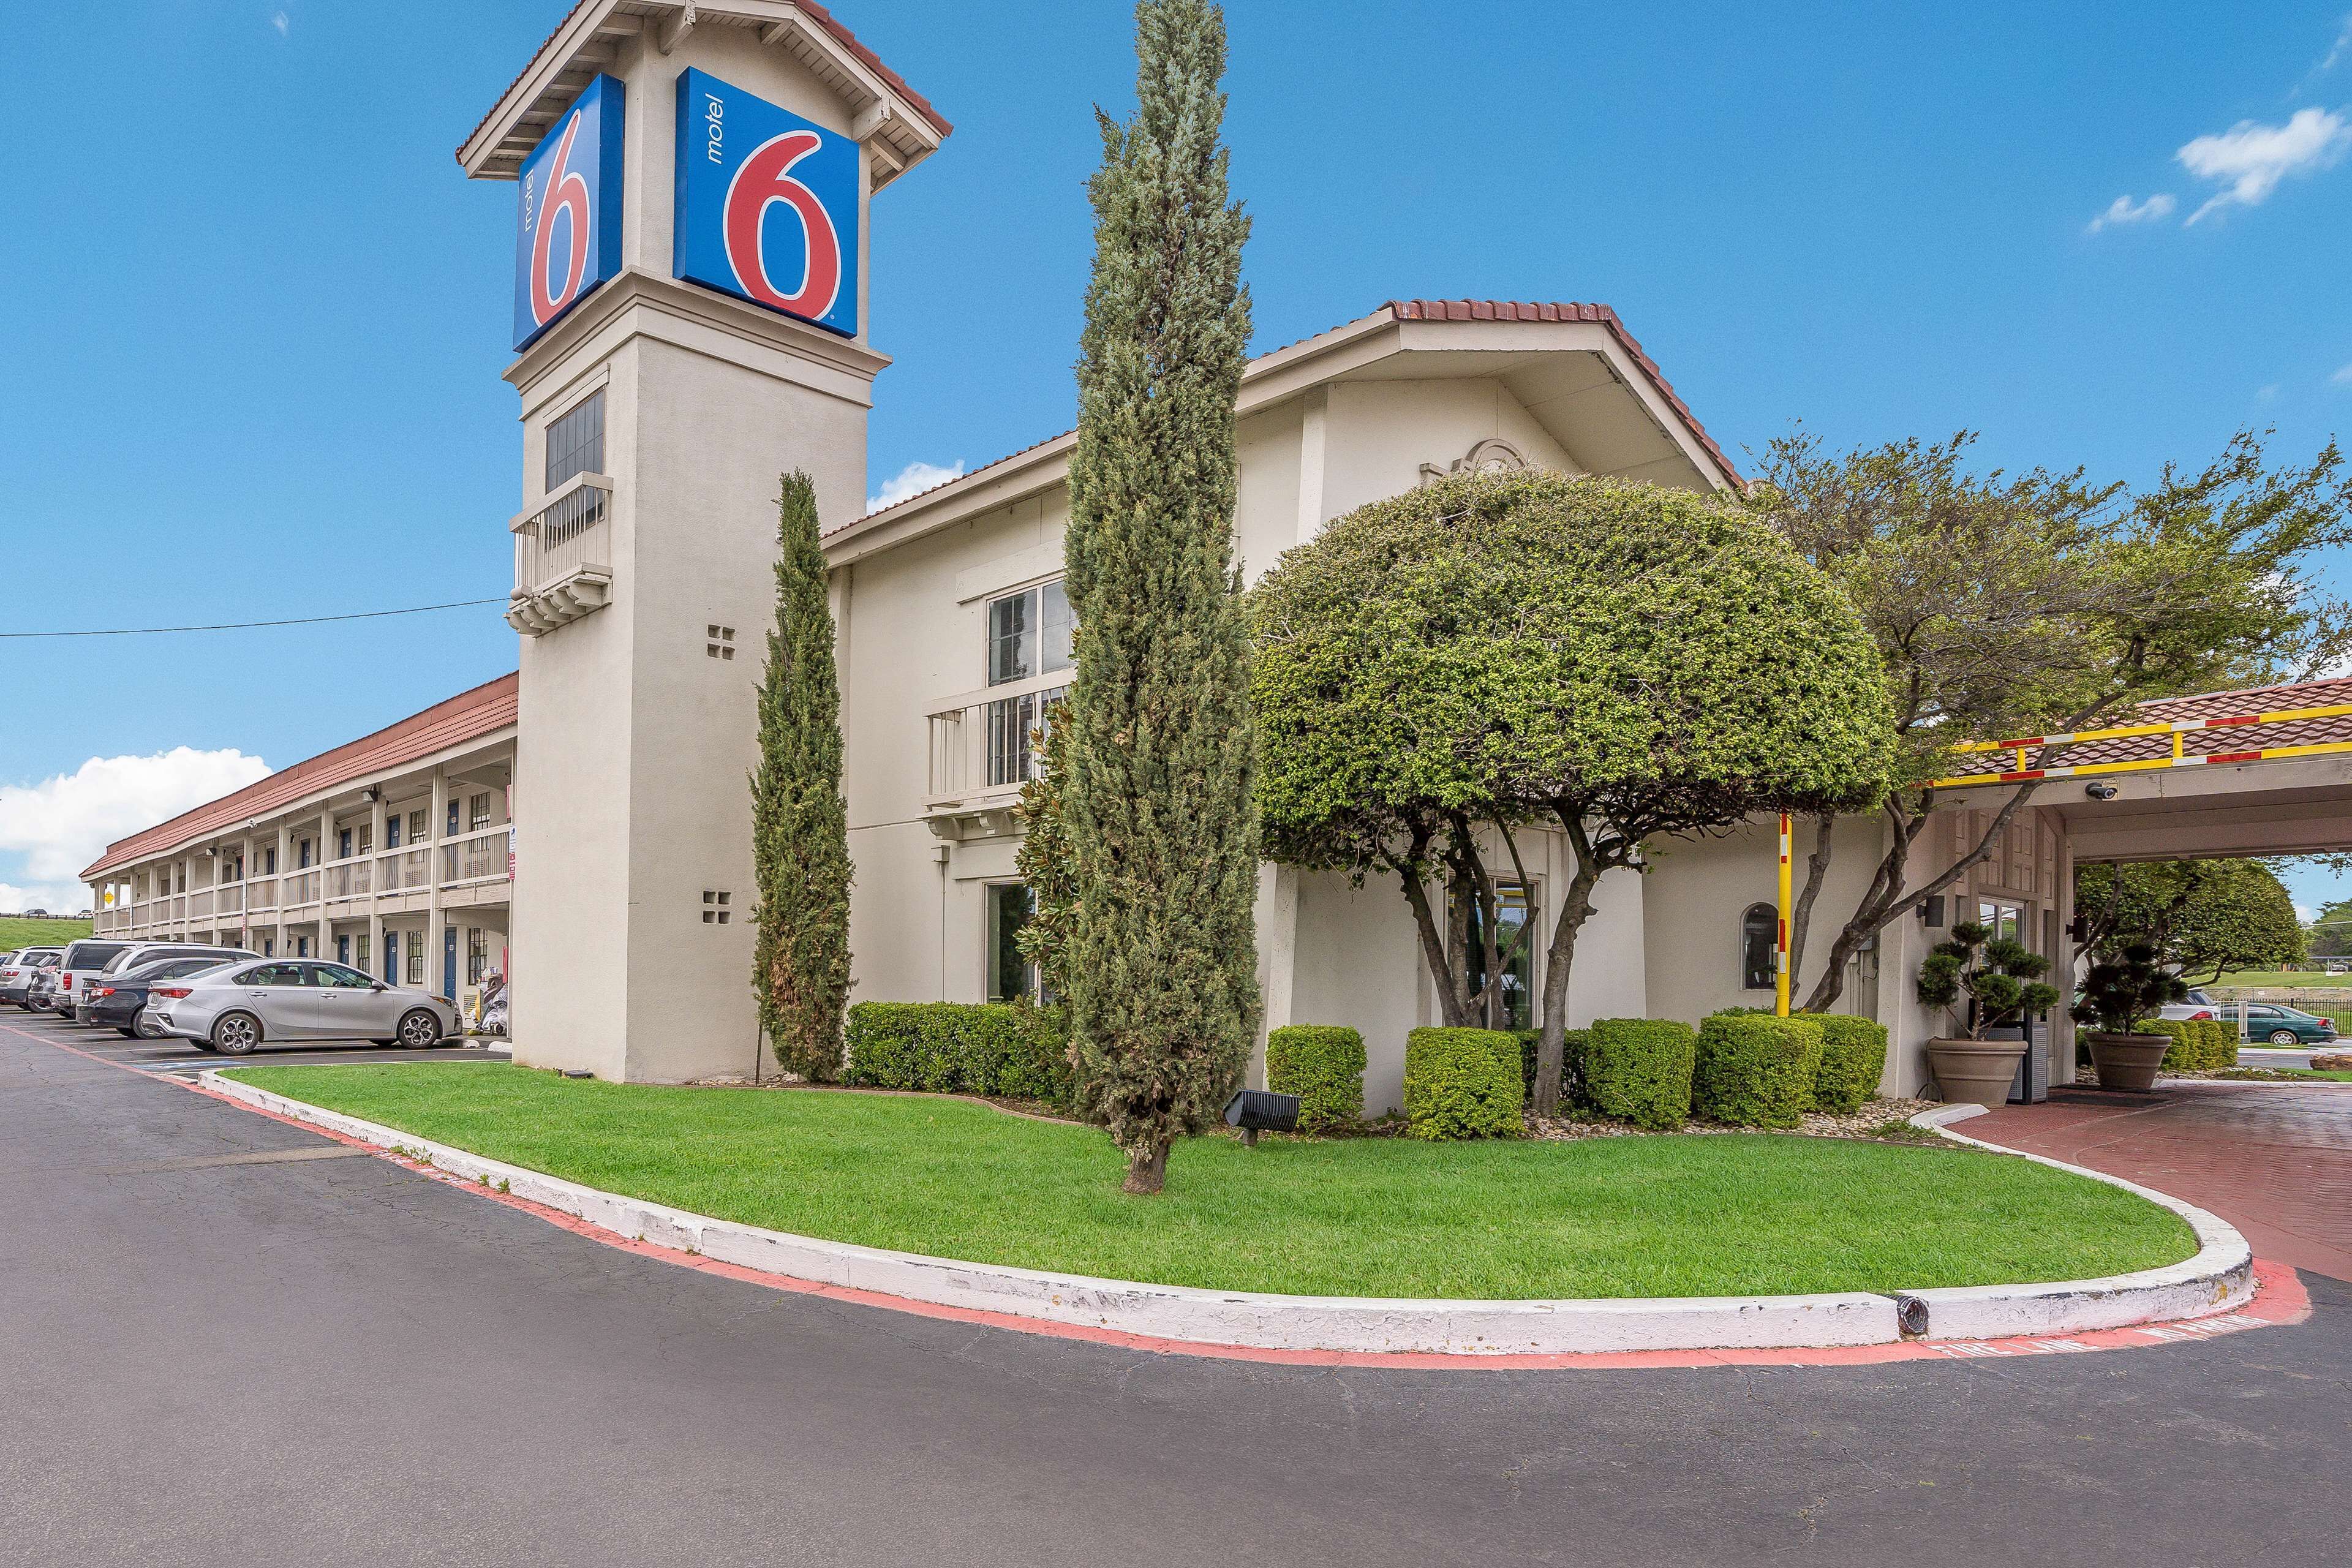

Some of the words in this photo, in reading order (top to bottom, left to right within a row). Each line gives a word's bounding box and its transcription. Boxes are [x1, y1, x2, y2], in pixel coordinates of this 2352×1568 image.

[705, 93, 723, 165] motel
[524, 168, 534, 233] motel
[530, 108, 590, 328] 6
[722, 130, 842, 320] 6
[1928, 1342, 2014, 1358] FIRE
[2004, 1339, 2100, 1352] LANE
